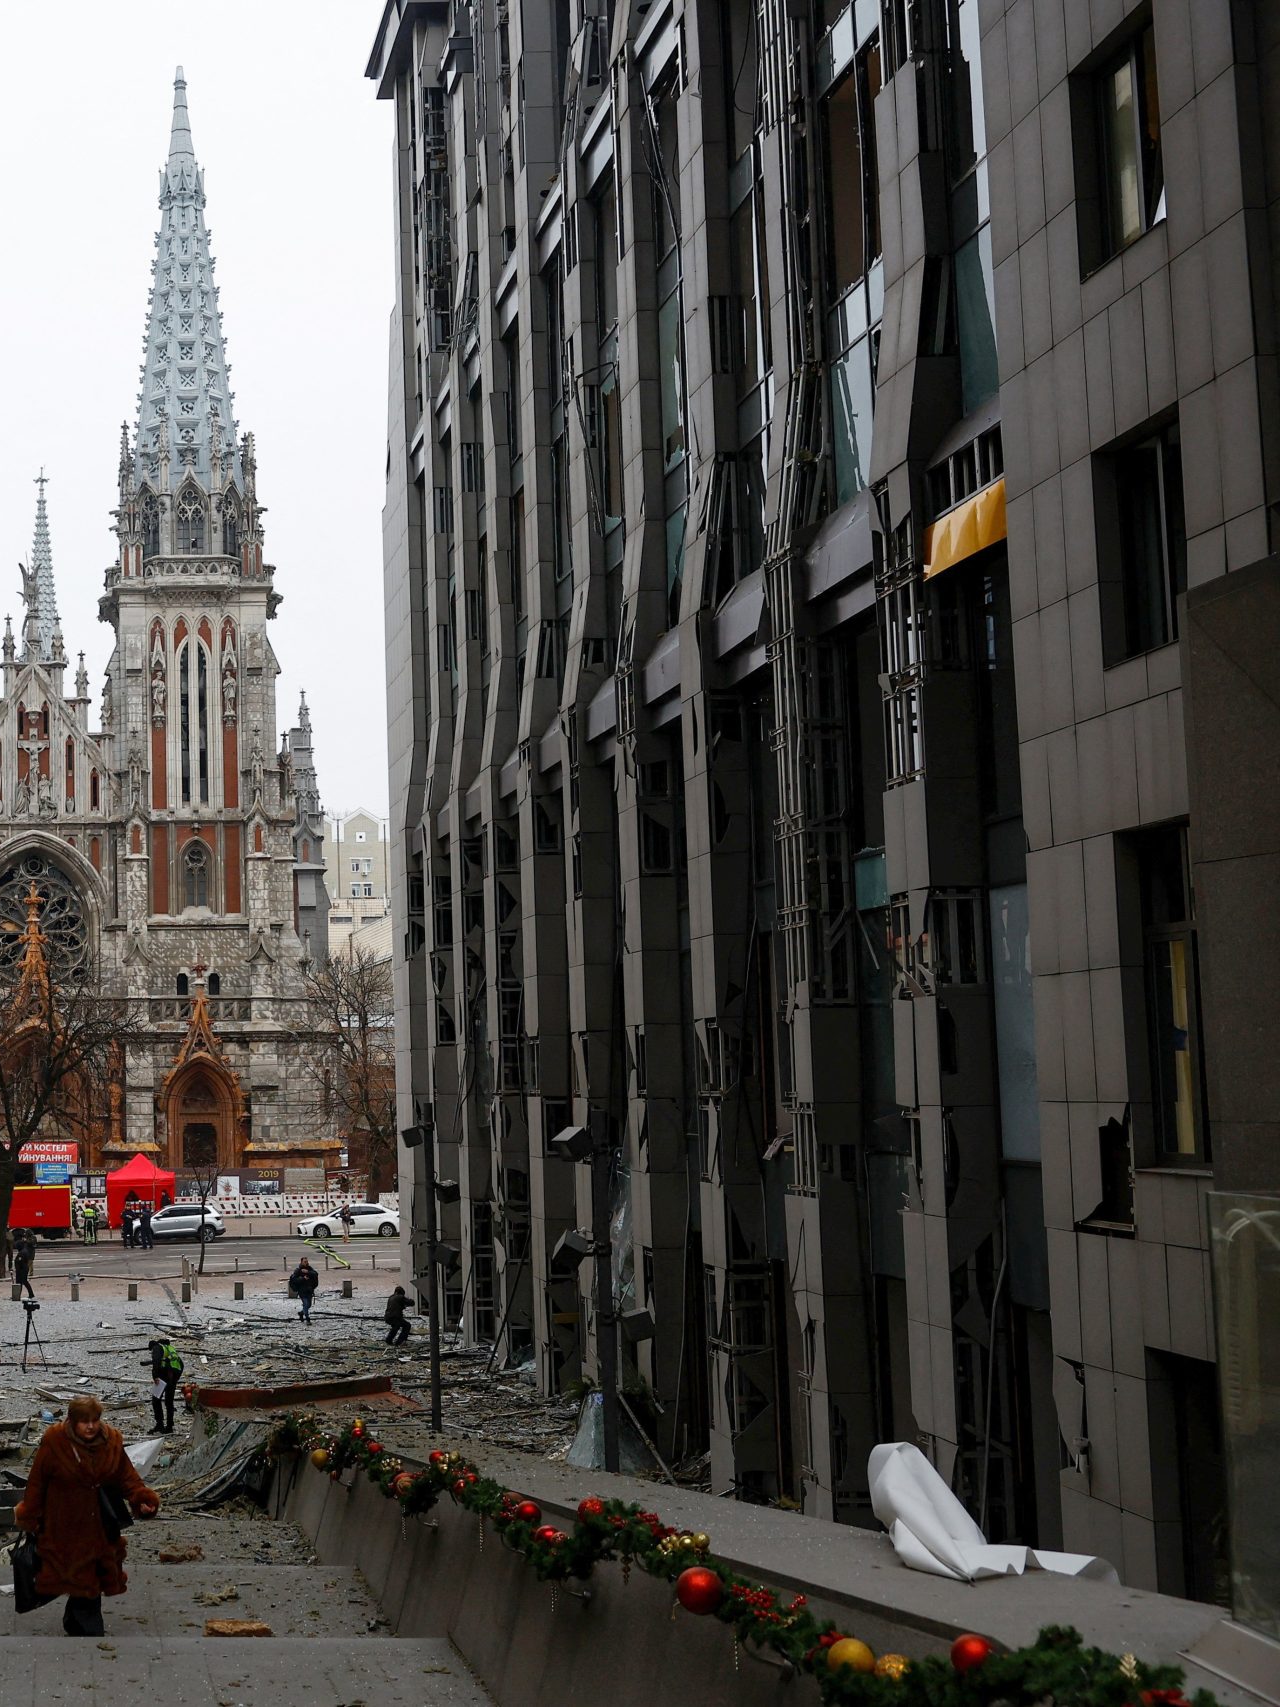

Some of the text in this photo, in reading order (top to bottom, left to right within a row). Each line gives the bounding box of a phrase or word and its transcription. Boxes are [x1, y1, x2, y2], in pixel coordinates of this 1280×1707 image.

[34, 1144, 67, 1152] КОСТЕЛ
[18, 1152, 72, 1161] УЙНУВАННЯ!
[258, 1170, 279, 1178] 2019
